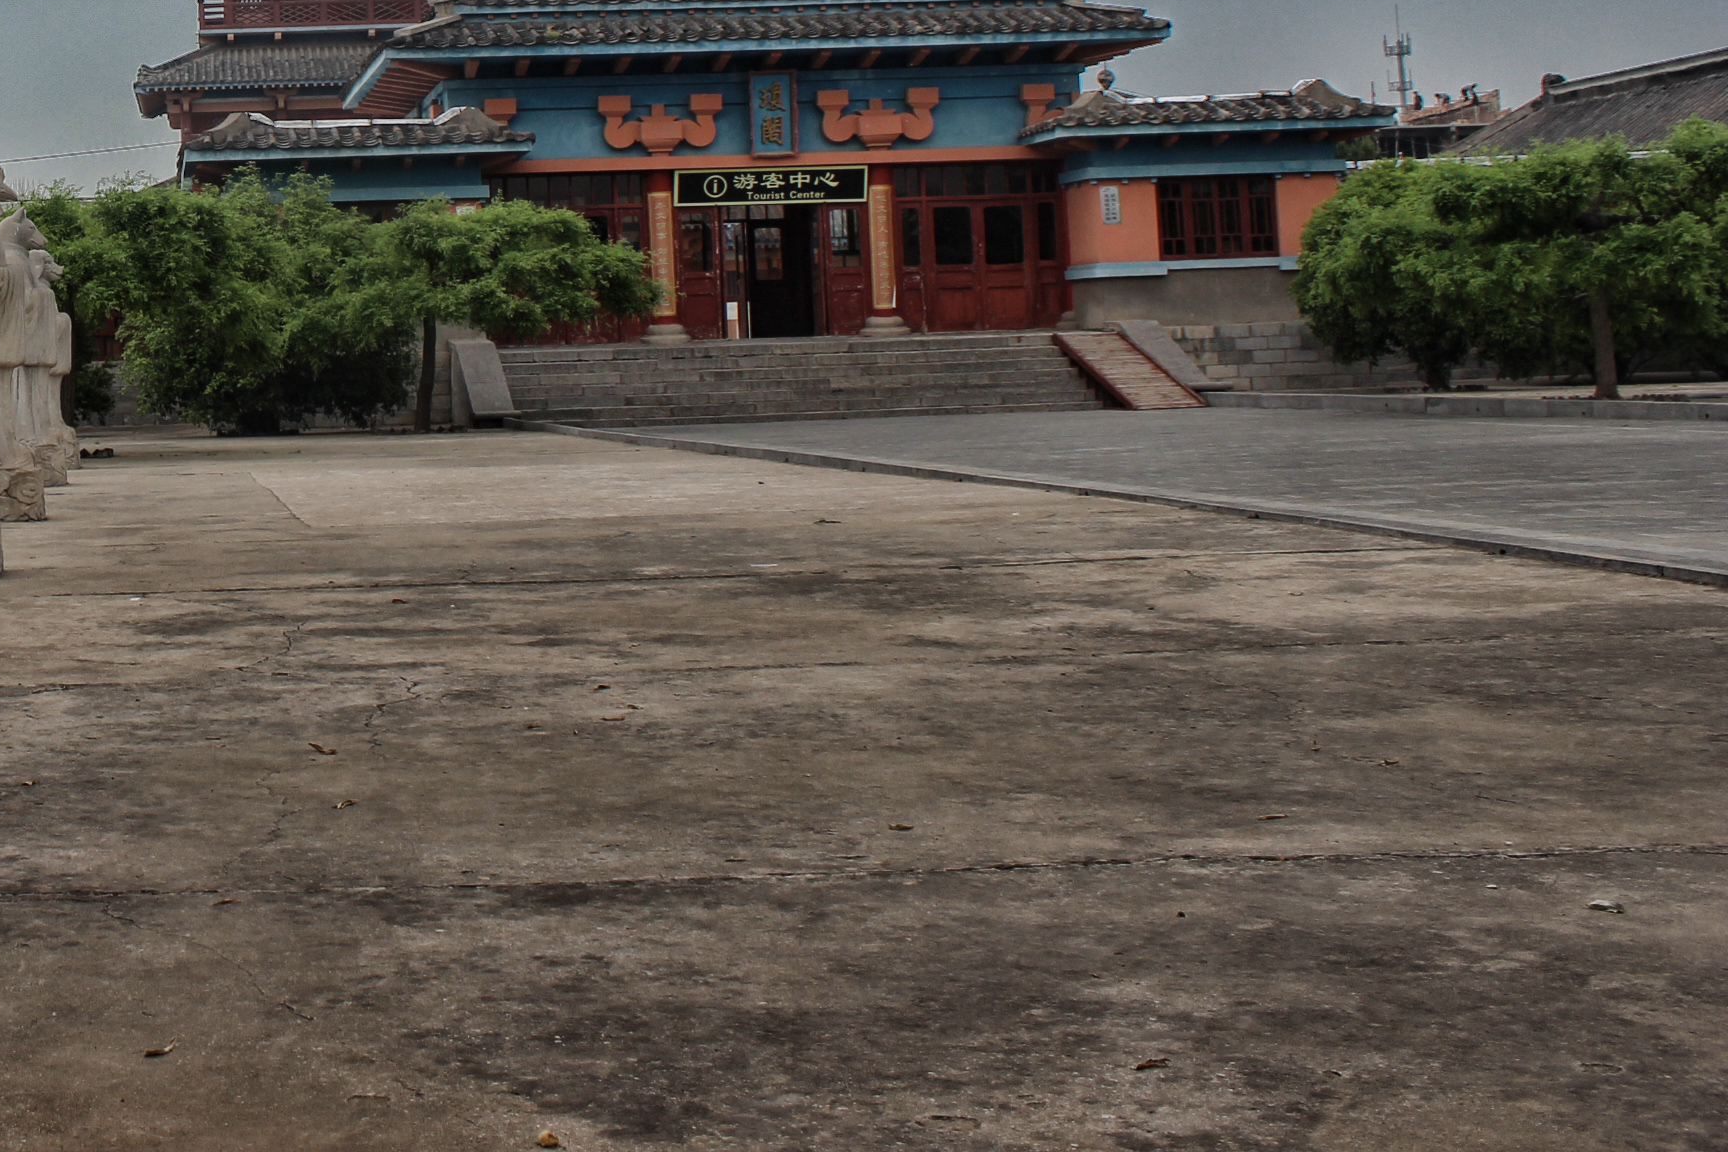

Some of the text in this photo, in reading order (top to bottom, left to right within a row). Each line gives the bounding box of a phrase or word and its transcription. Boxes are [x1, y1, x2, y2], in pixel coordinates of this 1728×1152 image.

[733, 171, 840, 190] 游客中心
[747, 190, 825, 200] Tourist Center
